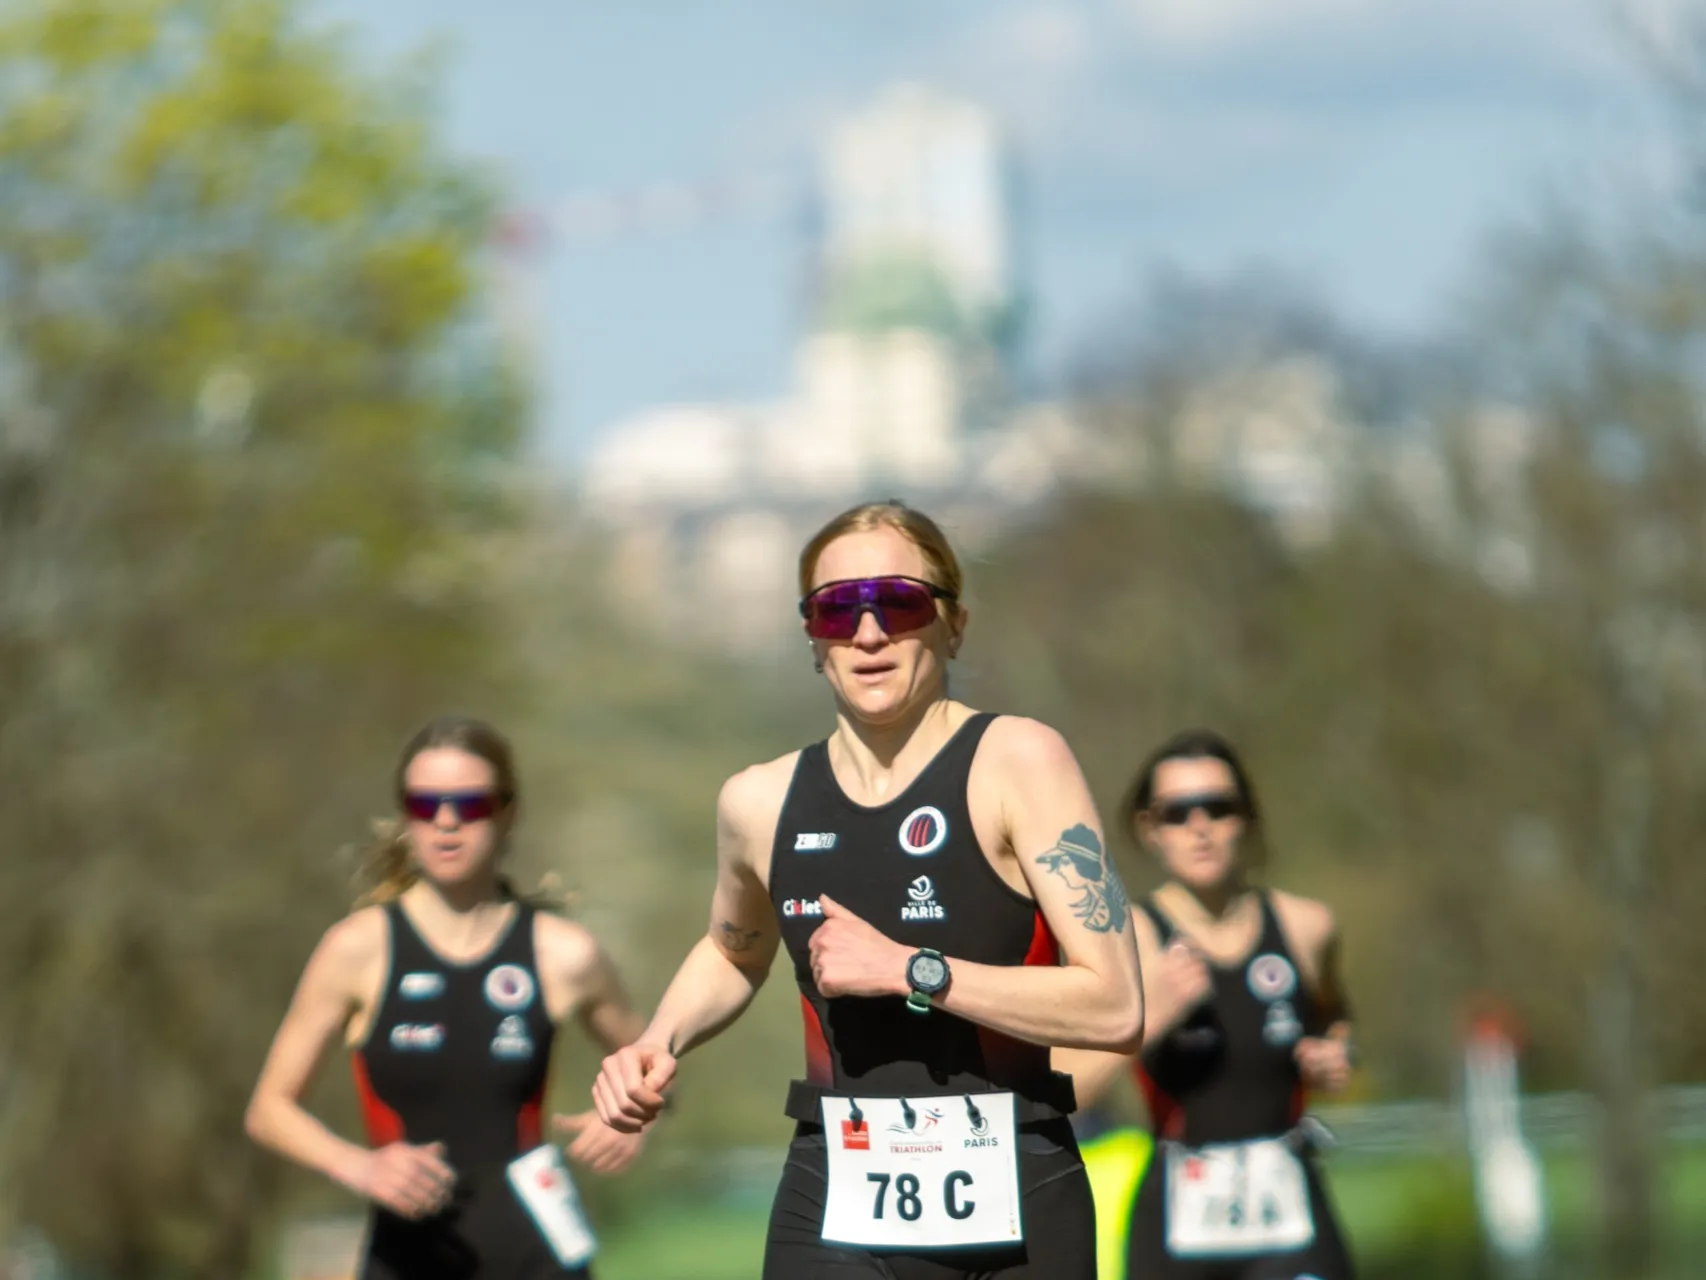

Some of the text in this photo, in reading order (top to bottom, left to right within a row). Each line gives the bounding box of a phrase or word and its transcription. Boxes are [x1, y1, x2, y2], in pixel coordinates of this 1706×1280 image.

[901, 905, 944, 920] PARIS
[889, 1145, 943, 1154] TRIATHLON
[964, 1137, 998, 1149] PARIS
[866, 1172, 922, 1221] 78
[943, 1169, 976, 1220] C
